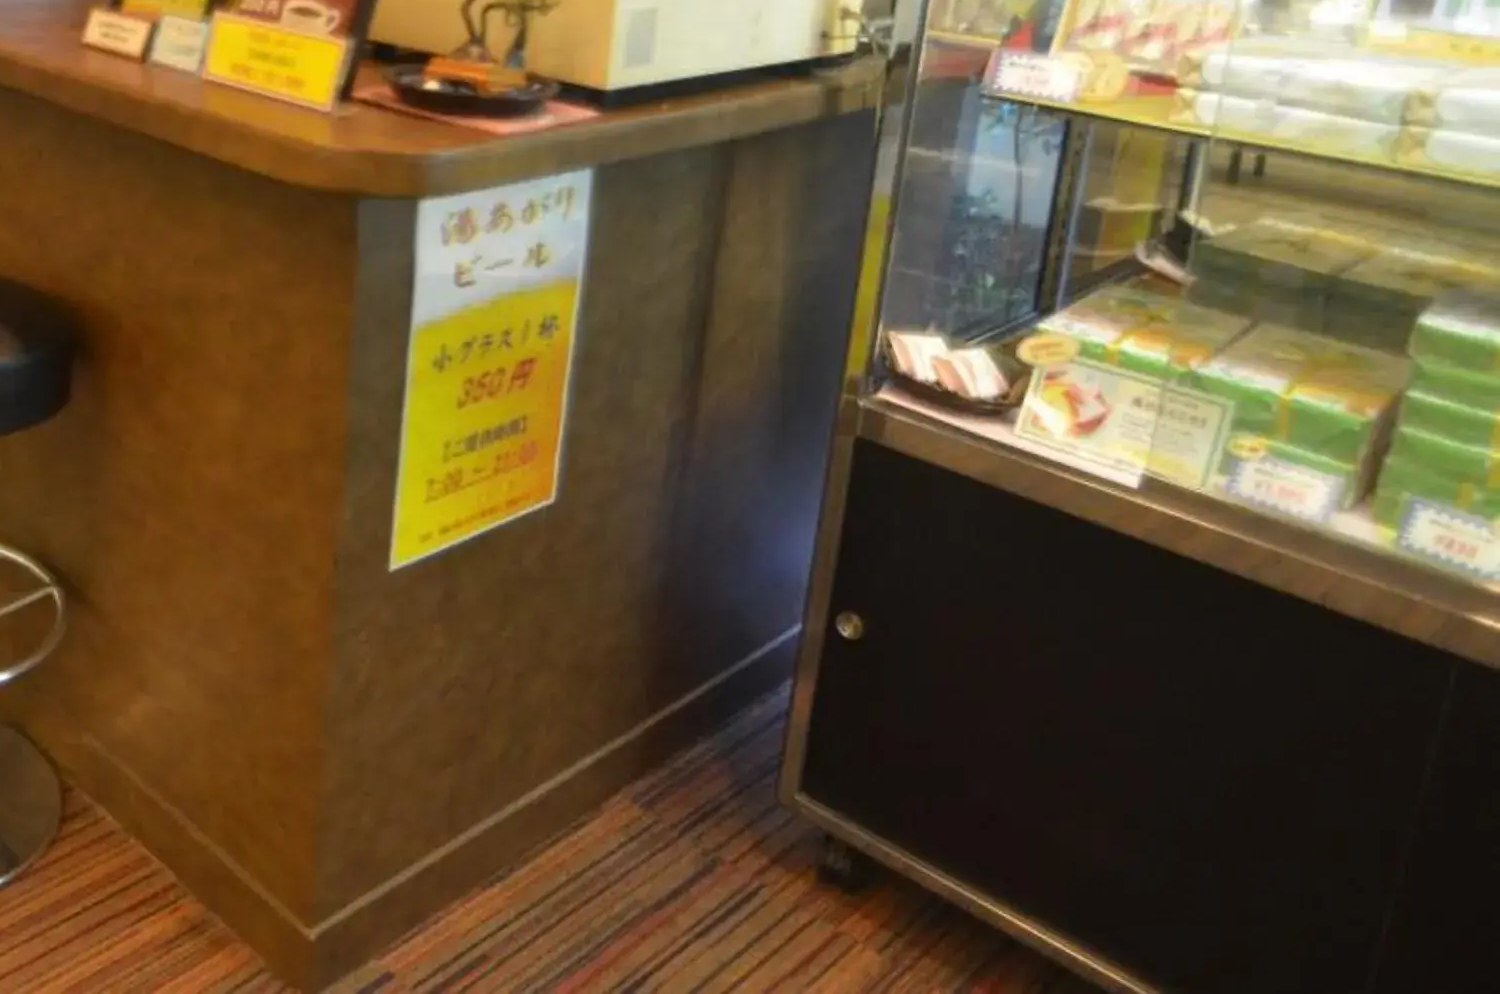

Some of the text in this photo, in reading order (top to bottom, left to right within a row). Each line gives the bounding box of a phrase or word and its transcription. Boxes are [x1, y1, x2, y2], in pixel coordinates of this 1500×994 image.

[440, 184, 577, 247] 湯あがり
[453, 242, 551, 289] ビール
